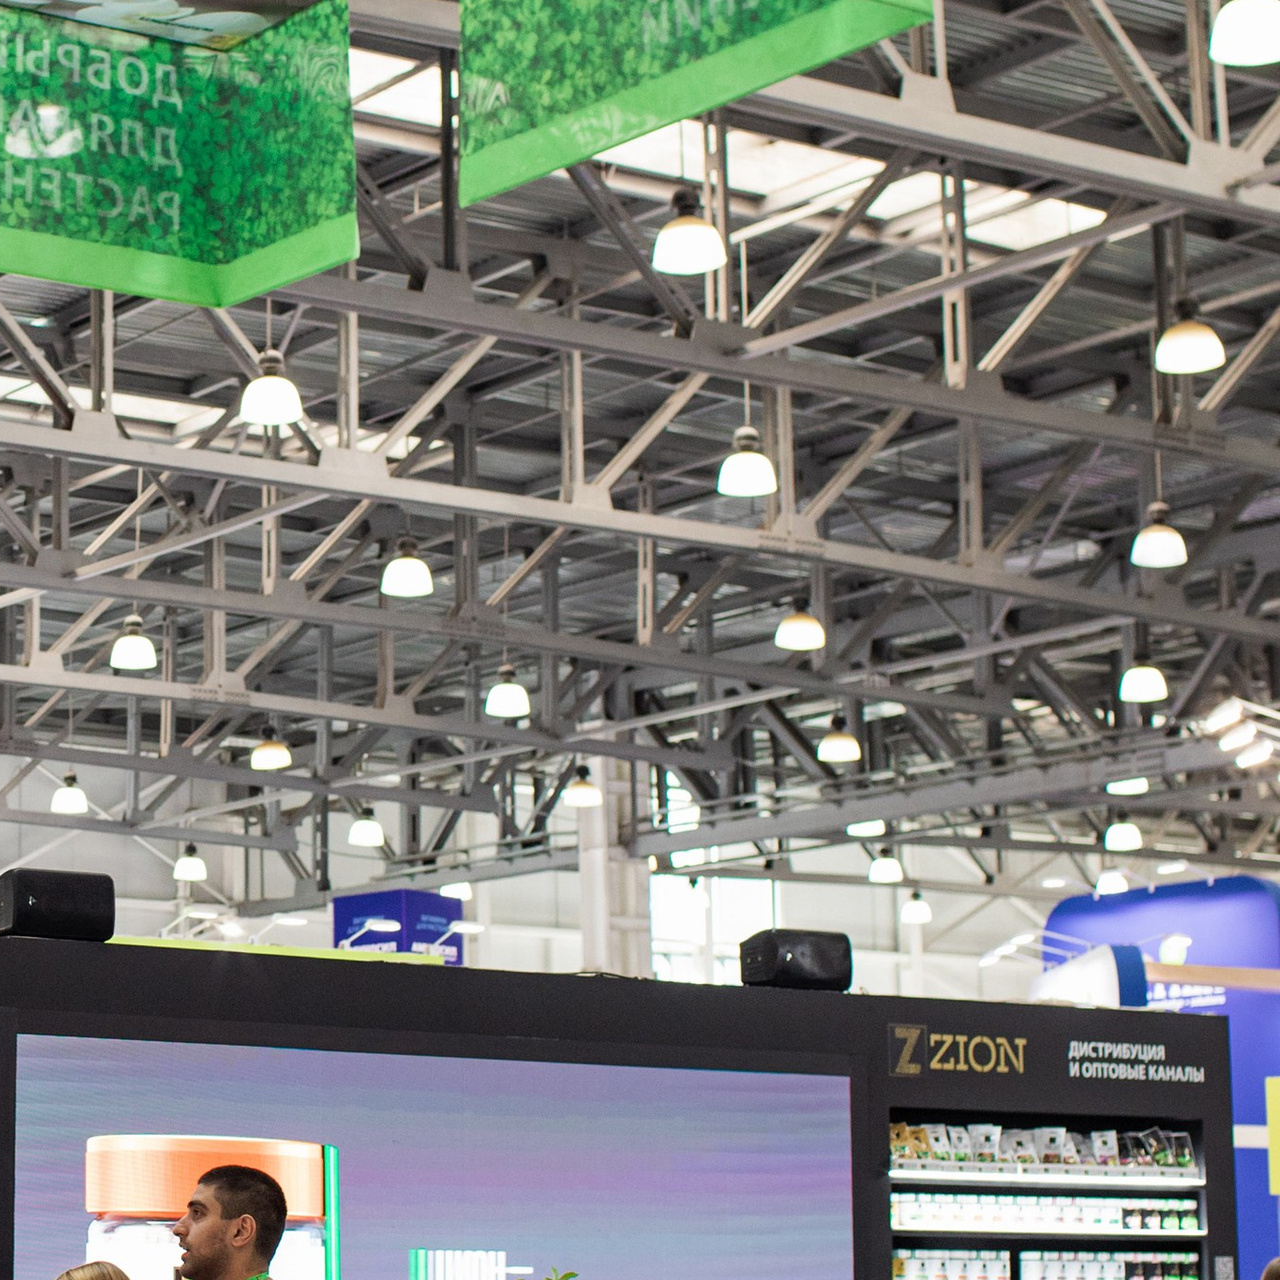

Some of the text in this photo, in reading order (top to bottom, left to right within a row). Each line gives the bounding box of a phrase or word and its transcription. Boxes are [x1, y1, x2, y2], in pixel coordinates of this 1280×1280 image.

[930, 1032, 1026, 1074] ZION
[1069, 1040, 1165, 1063] ДИСТРИБУЦИЯ
[1069, 1062, 1205, 1083] И ОПТОВЫЕ КАНАЛЫ
